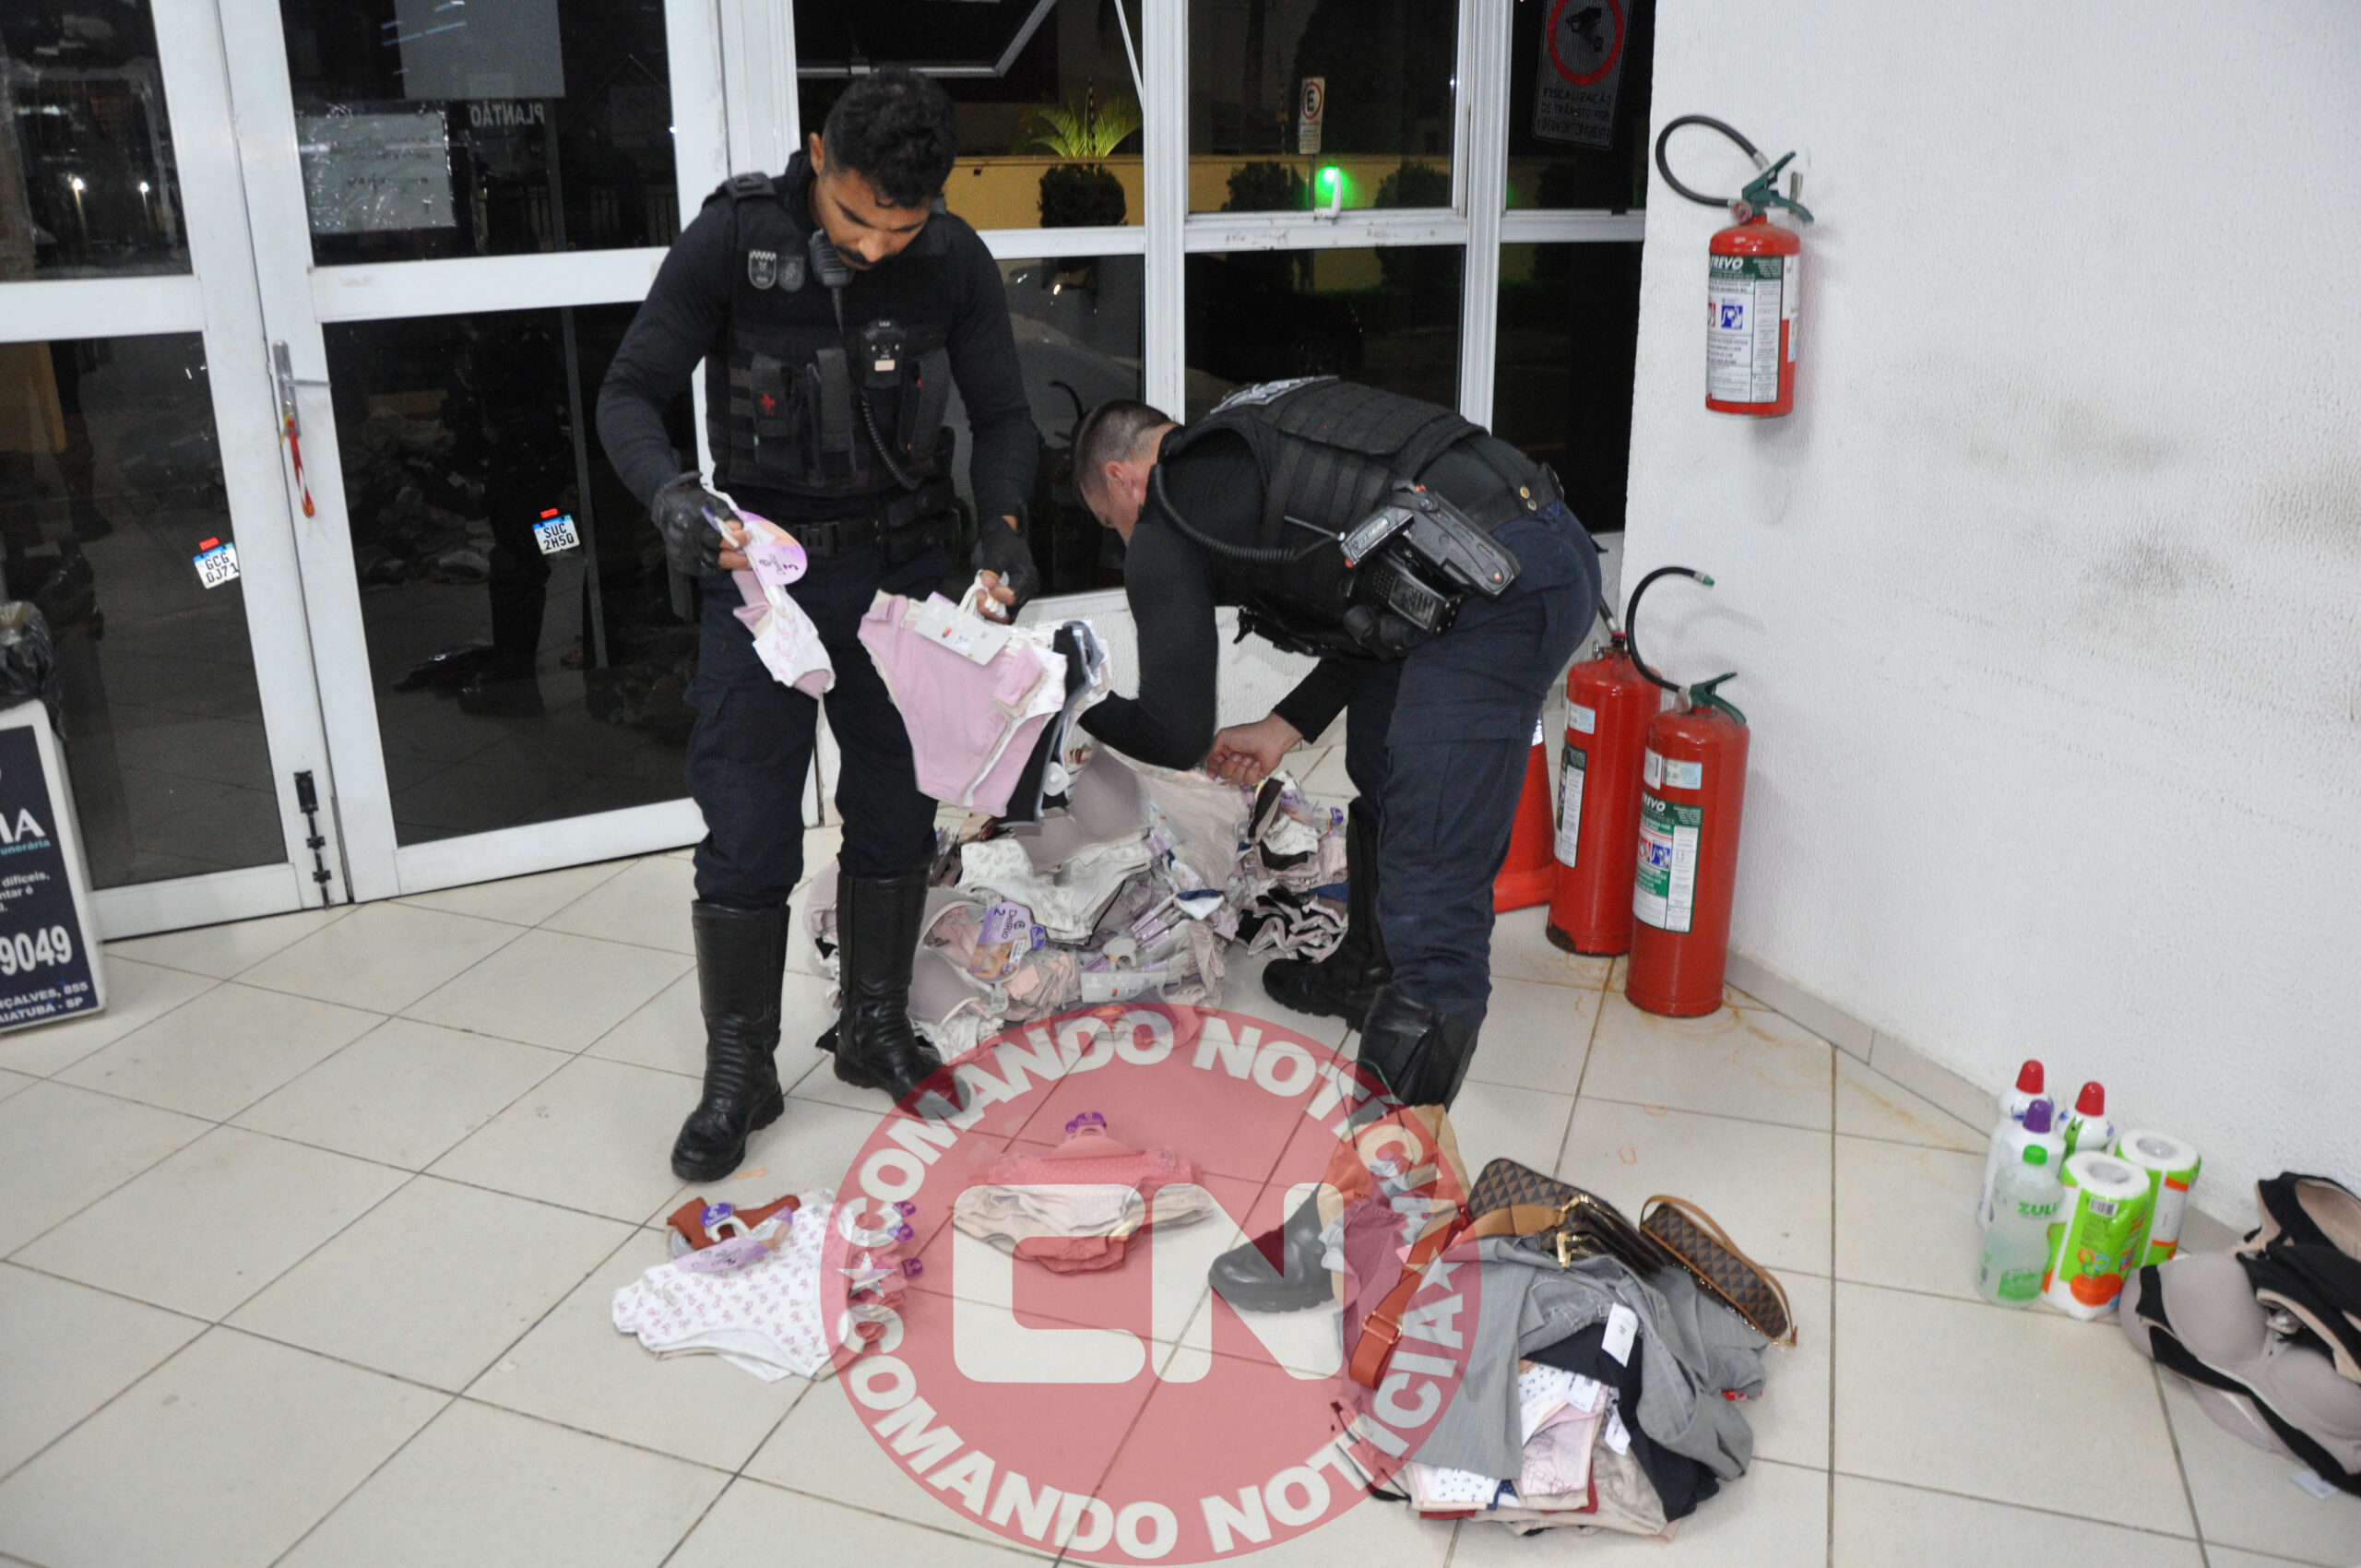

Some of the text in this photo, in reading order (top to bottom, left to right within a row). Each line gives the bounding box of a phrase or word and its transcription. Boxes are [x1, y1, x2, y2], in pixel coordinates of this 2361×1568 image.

[1307, 89, 1315, 112] E
[543, 523, 566, 538] SUC
[543, 533, 574, 551] 2H50
[205, 552, 230, 570] GCG
[0, 839, 51, 856] unerária
[1002, 909, 1017, 939] DelRio
[65, 996, 84, 1009] SP
